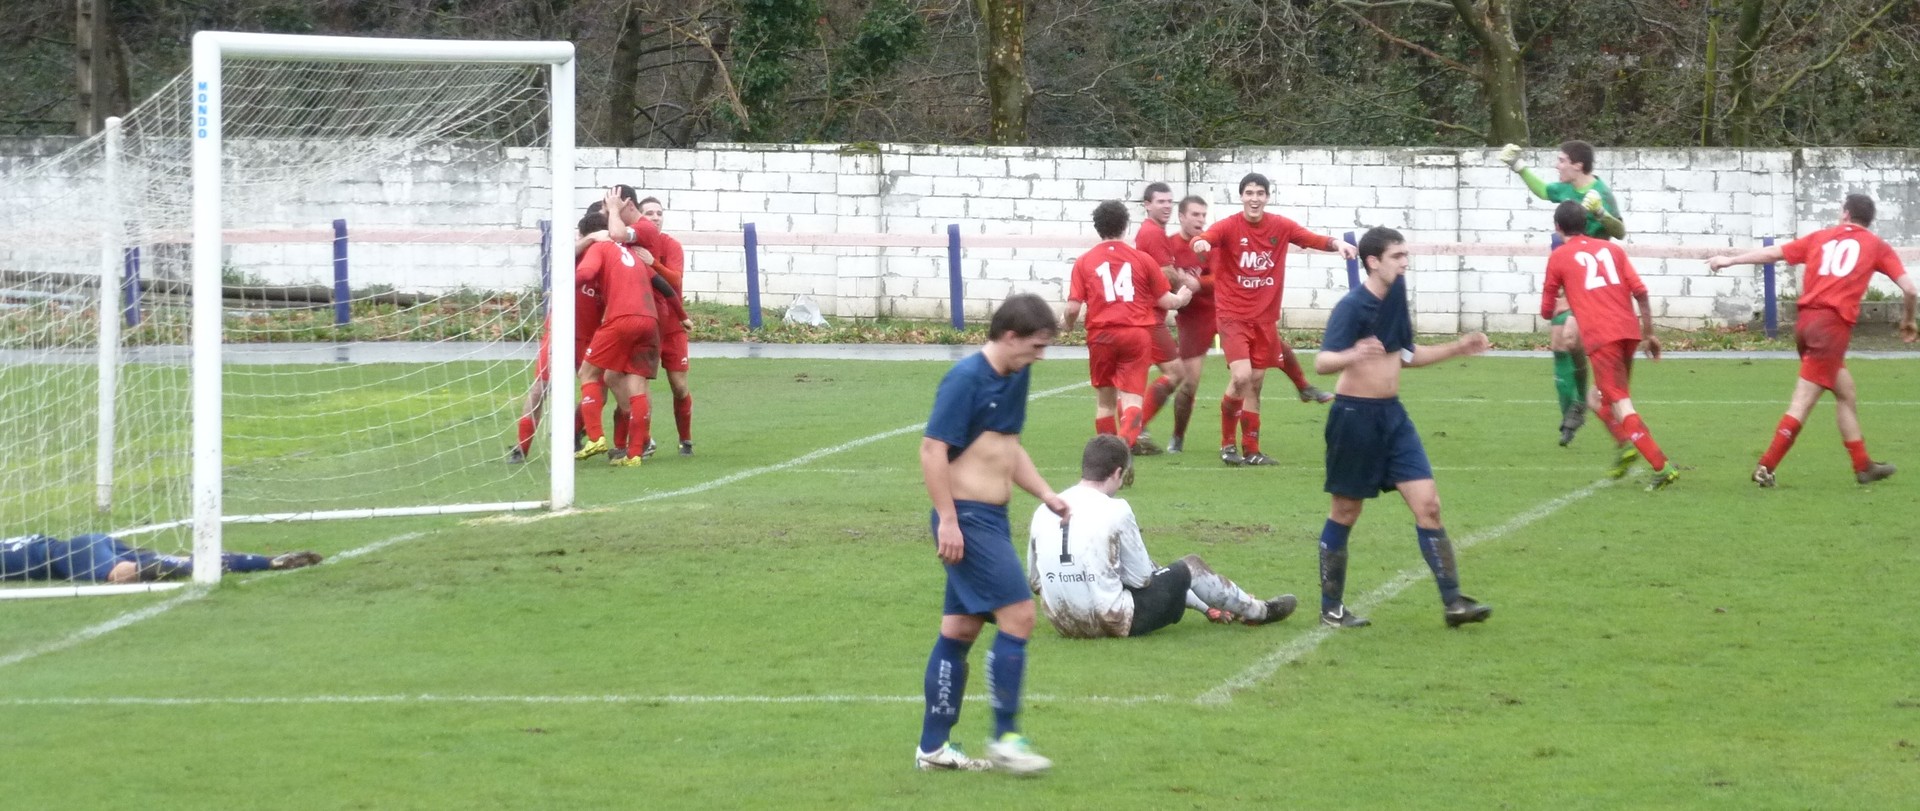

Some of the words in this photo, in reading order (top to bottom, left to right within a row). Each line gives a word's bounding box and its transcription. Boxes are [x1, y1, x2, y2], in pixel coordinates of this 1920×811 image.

[198, 82, 208, 138] MONDO
[1574, 247, 1621, 290] 21
[1818, 238, 1861, 277] 10
[1094, 261, 1135, 302] 14
[1060, 522, 1074, 566] 1
